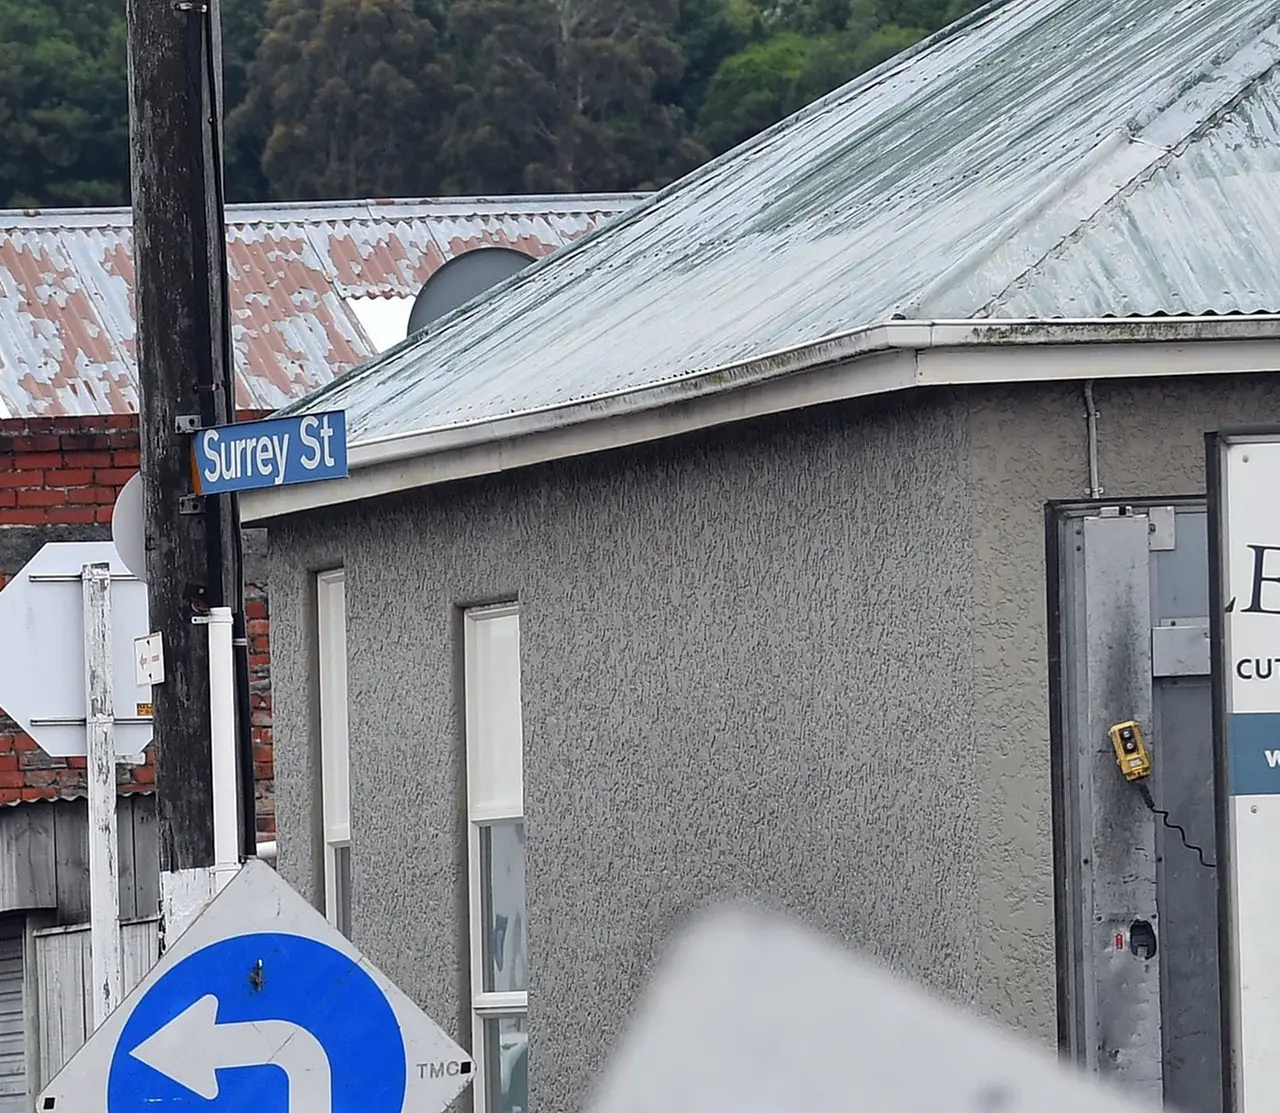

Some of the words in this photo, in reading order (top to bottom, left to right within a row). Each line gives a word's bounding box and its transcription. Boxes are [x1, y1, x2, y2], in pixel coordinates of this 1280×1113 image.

[203, 429, 289, 484] Surrey
[300, 414, 335, 470] St
[416, 1060, 459, 1079] TMC
